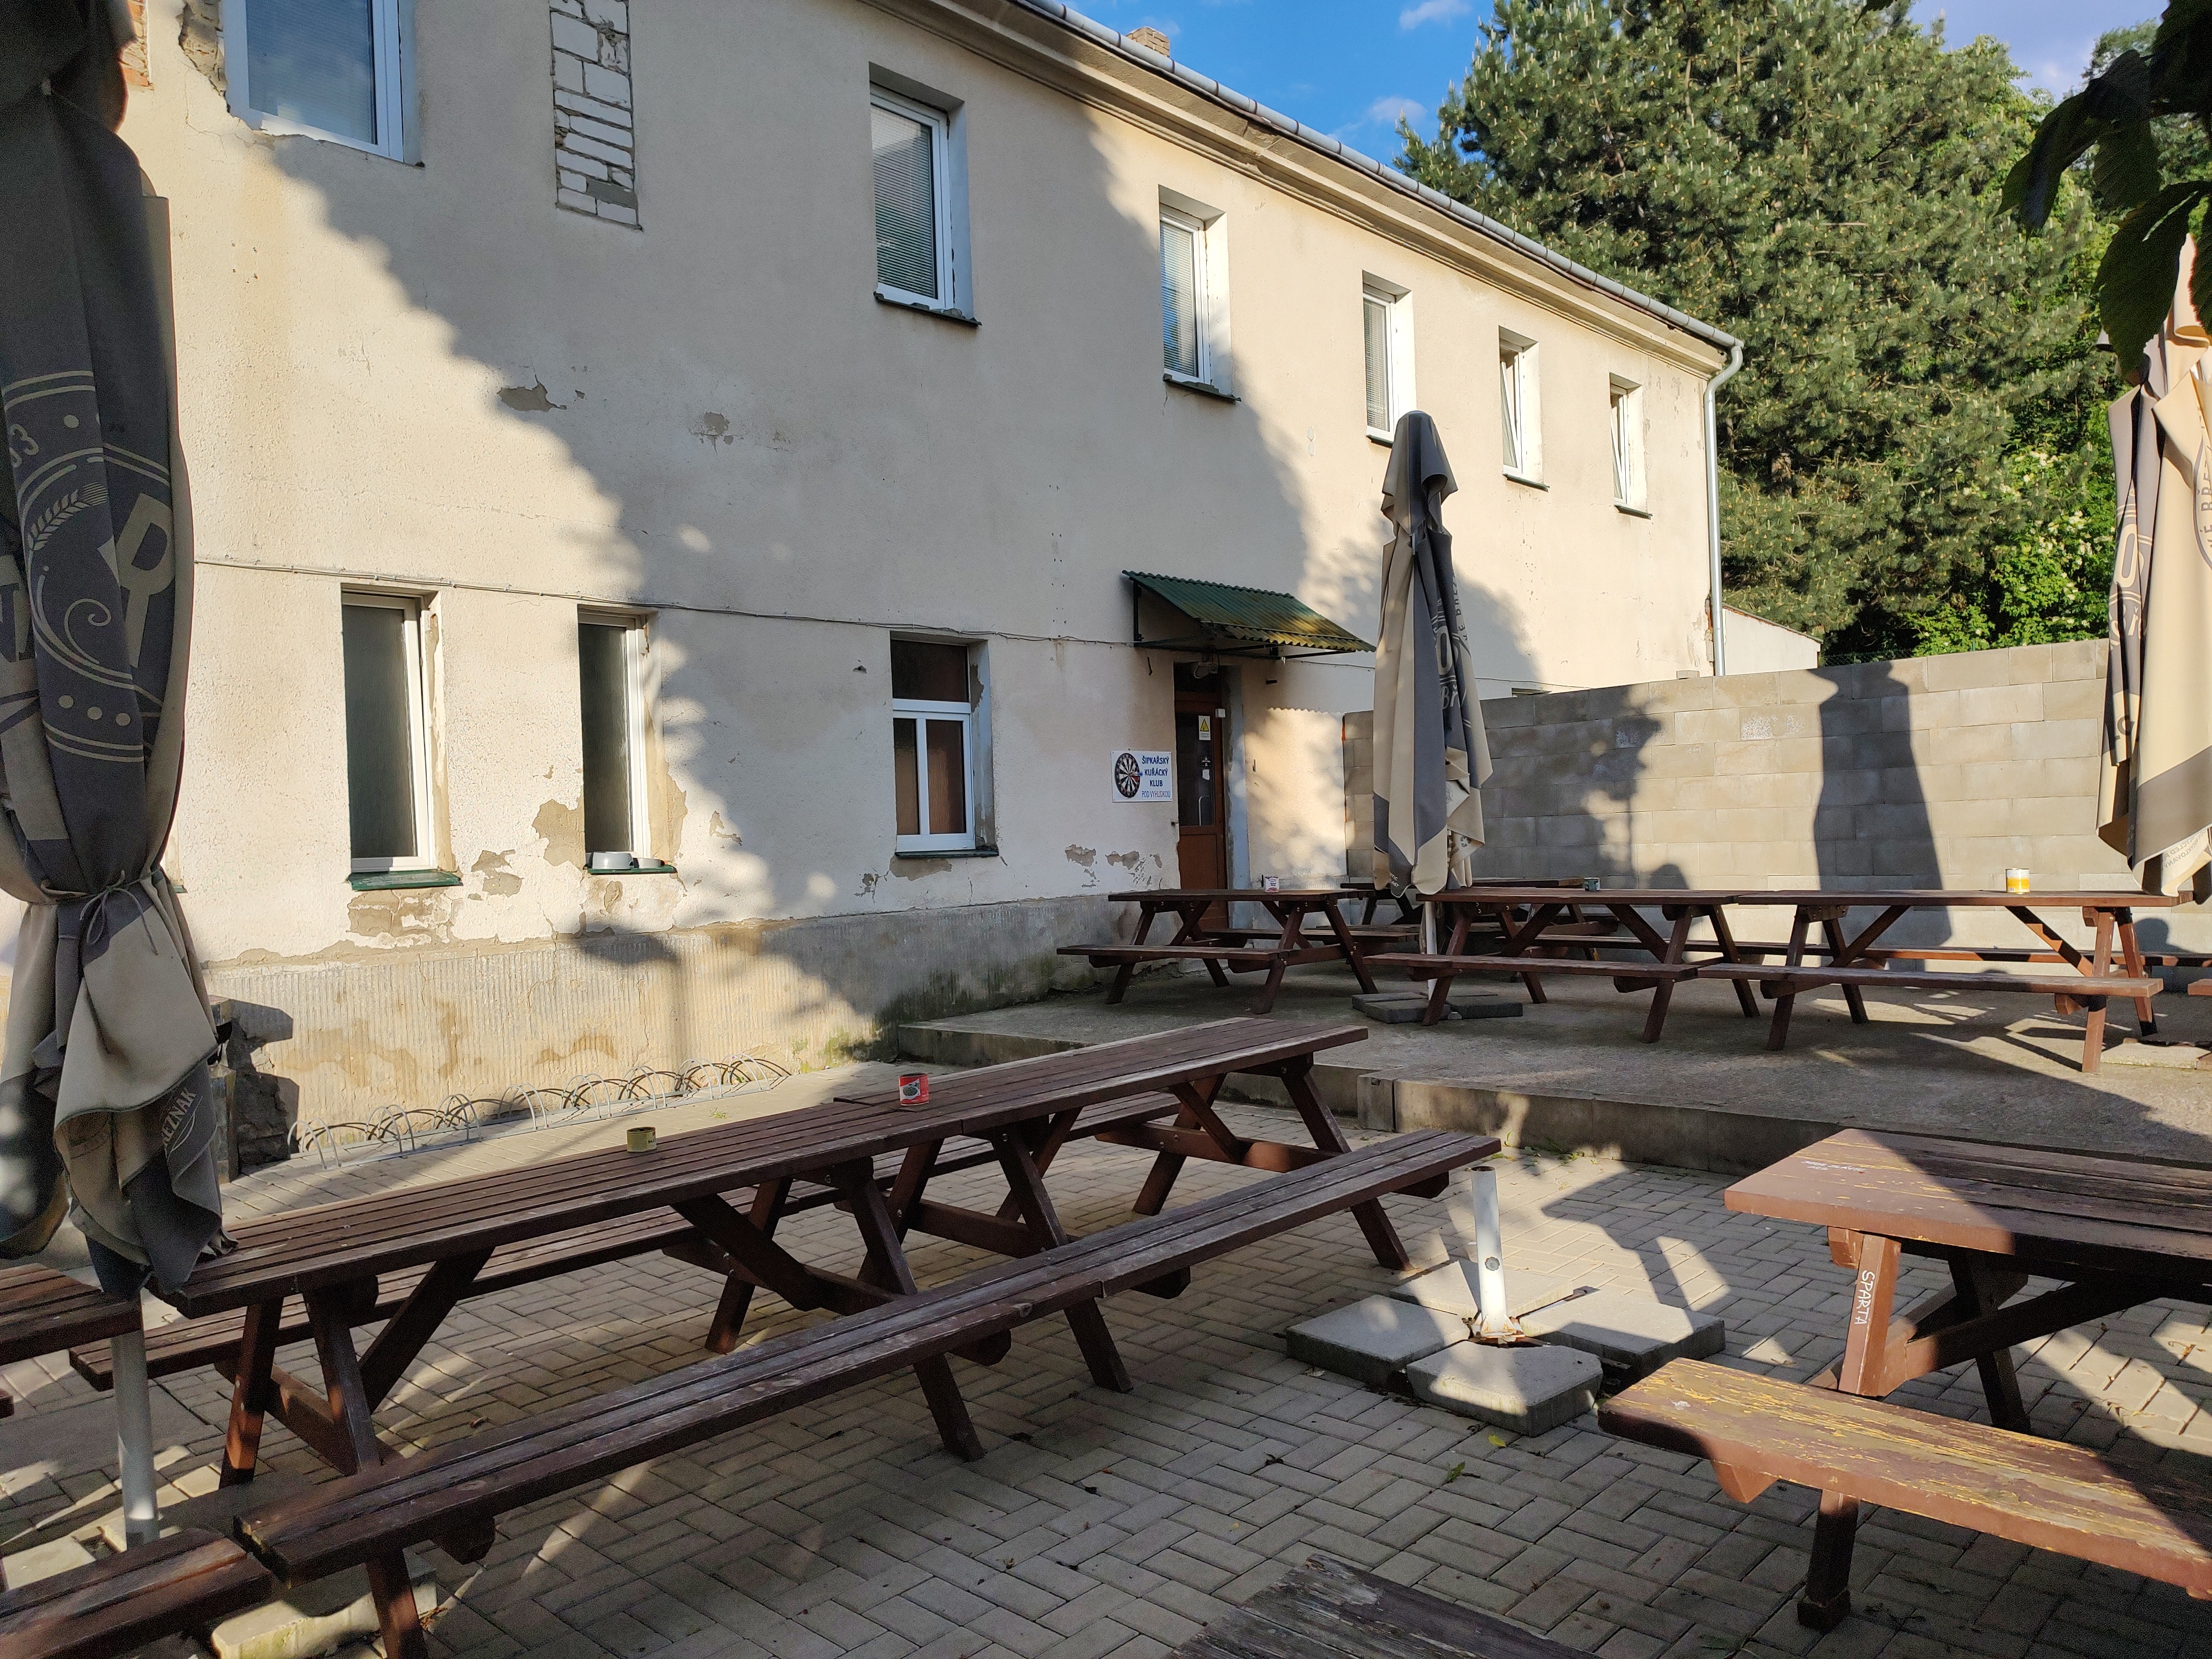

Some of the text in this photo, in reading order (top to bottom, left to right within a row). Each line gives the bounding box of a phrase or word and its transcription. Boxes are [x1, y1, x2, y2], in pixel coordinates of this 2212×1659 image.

[1142, 755, 1169, 764] ŠIPKAŘSKÝ
[1145, 768, 1167, 776] KUŘÁCKÝ
[1854, 1270, 1875, 1324] SPARTA
